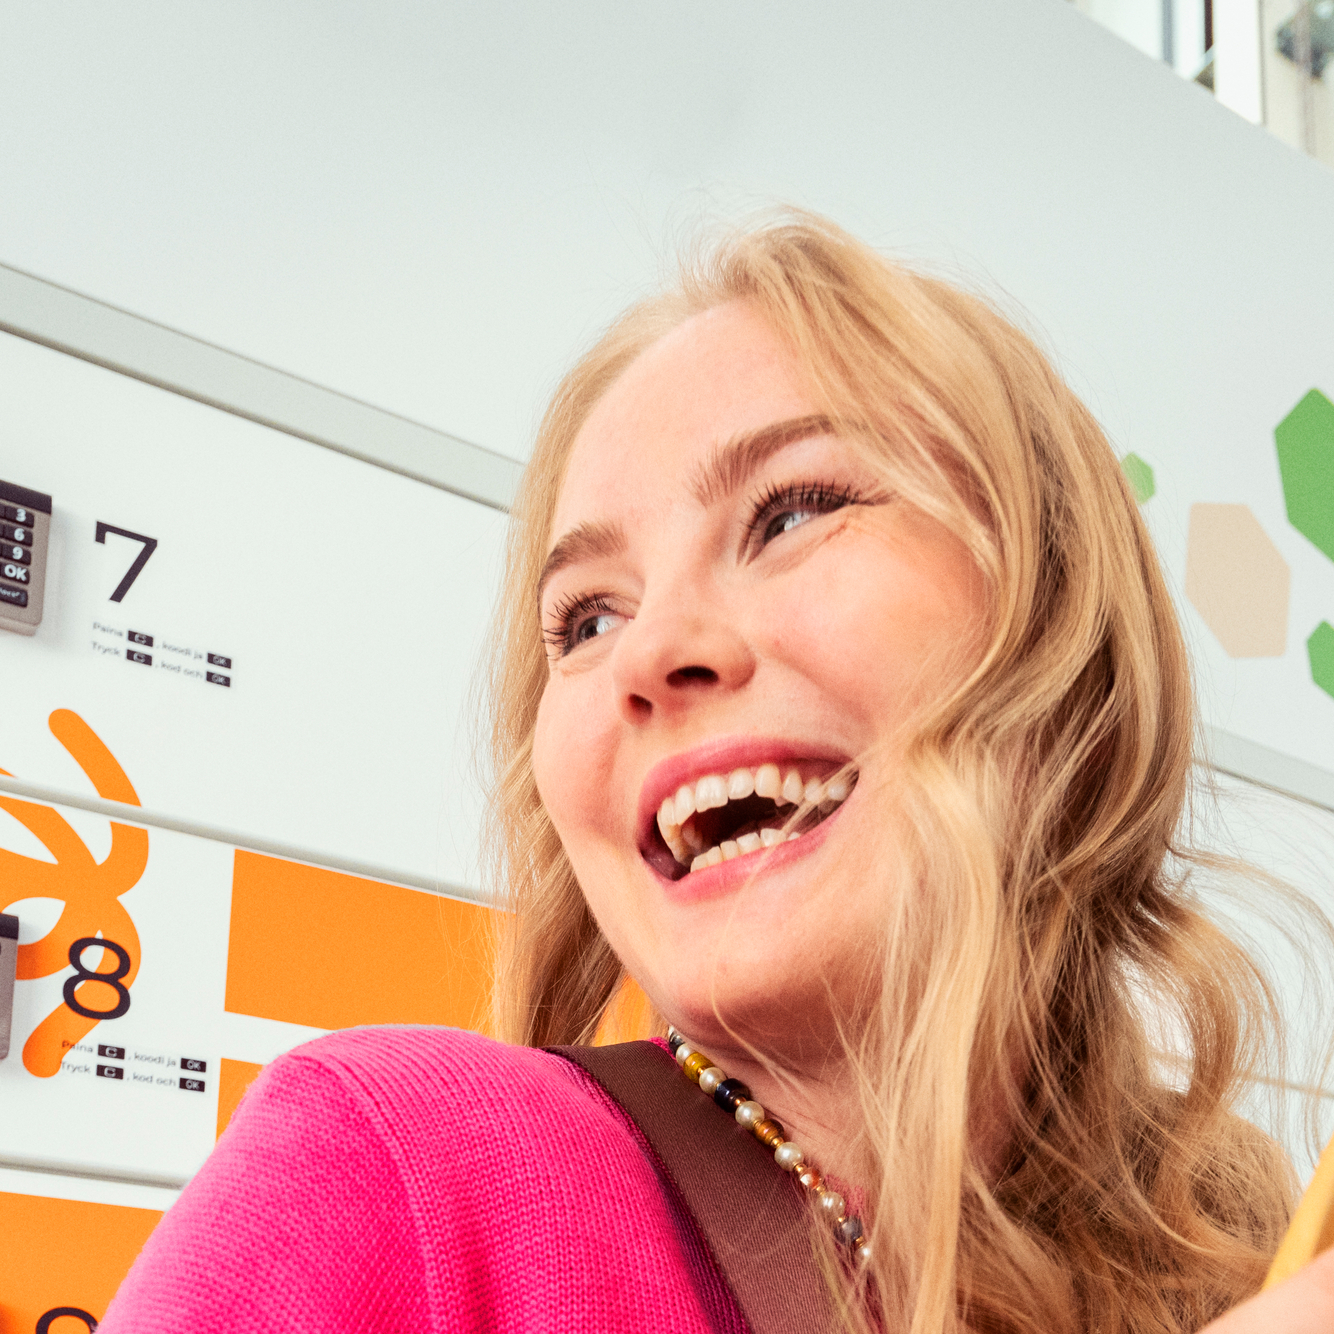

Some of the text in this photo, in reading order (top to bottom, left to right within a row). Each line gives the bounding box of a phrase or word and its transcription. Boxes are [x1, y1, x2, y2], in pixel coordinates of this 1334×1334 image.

[16, 509, 26, 522] 3
[14, 528, 25, 542] 6
[13, 547, 23, 560] 9
[95, 520, 158, 603] 7
[5, 564, 27, 582] OK
[63, 937, 131, 1021] 8
[62, 1041, 93, 1053] Paina
[61, 1062, 91, 1074] Tryck
